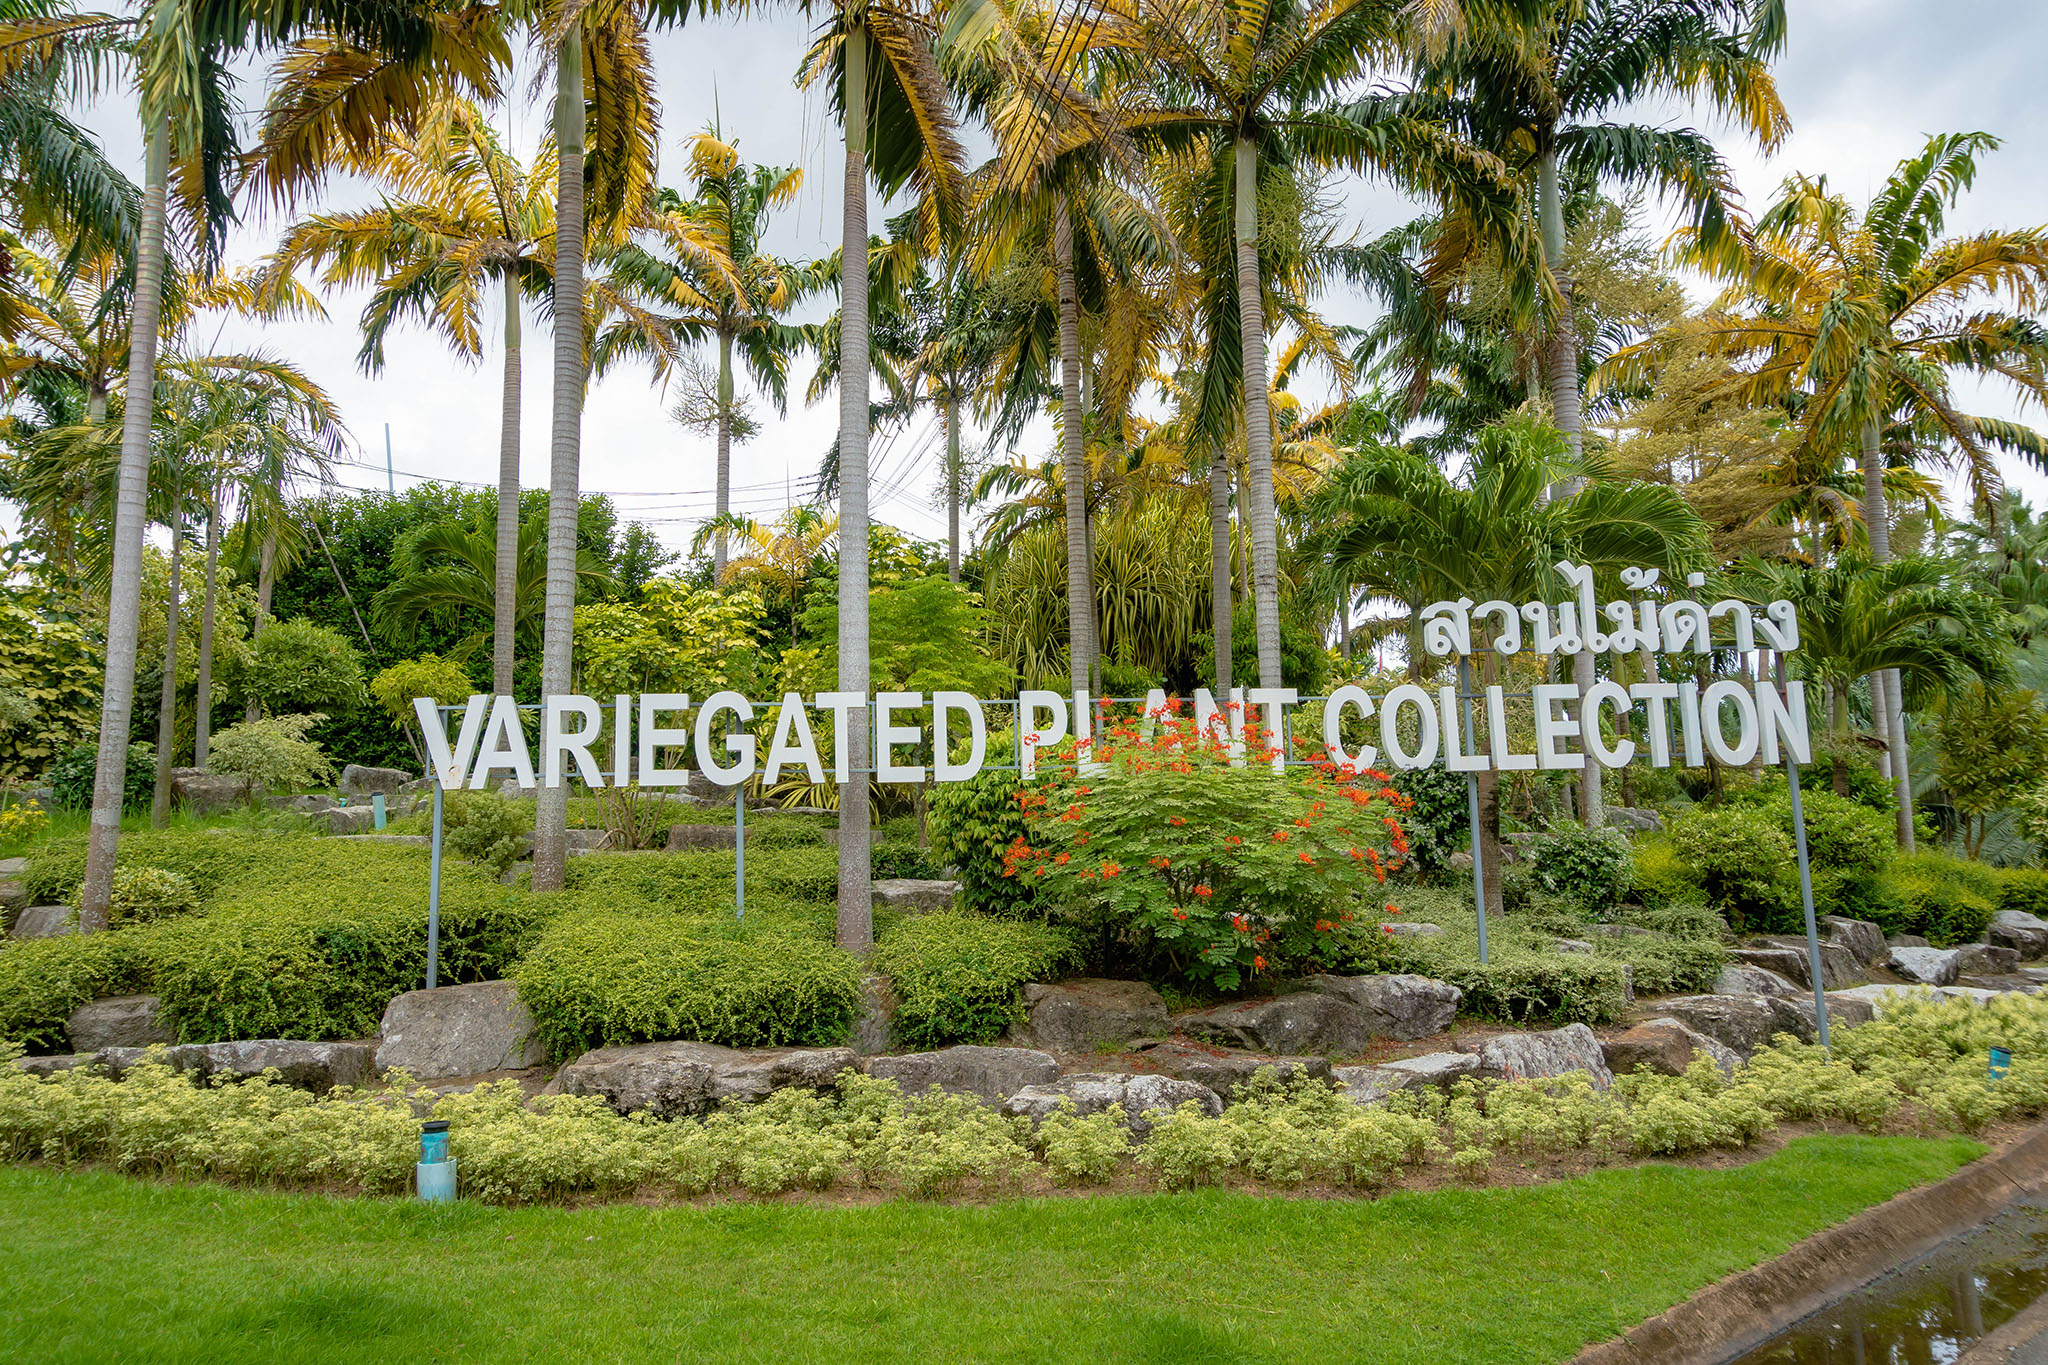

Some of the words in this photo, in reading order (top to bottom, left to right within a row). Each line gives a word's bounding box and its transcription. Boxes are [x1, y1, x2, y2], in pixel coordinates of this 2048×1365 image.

[1419, 560, 1799, 656] สวนไม้ด่าง
[414, 691, 987, 790] VARIEGATED
[1323, 680, 1811, 773] COLLECTION
